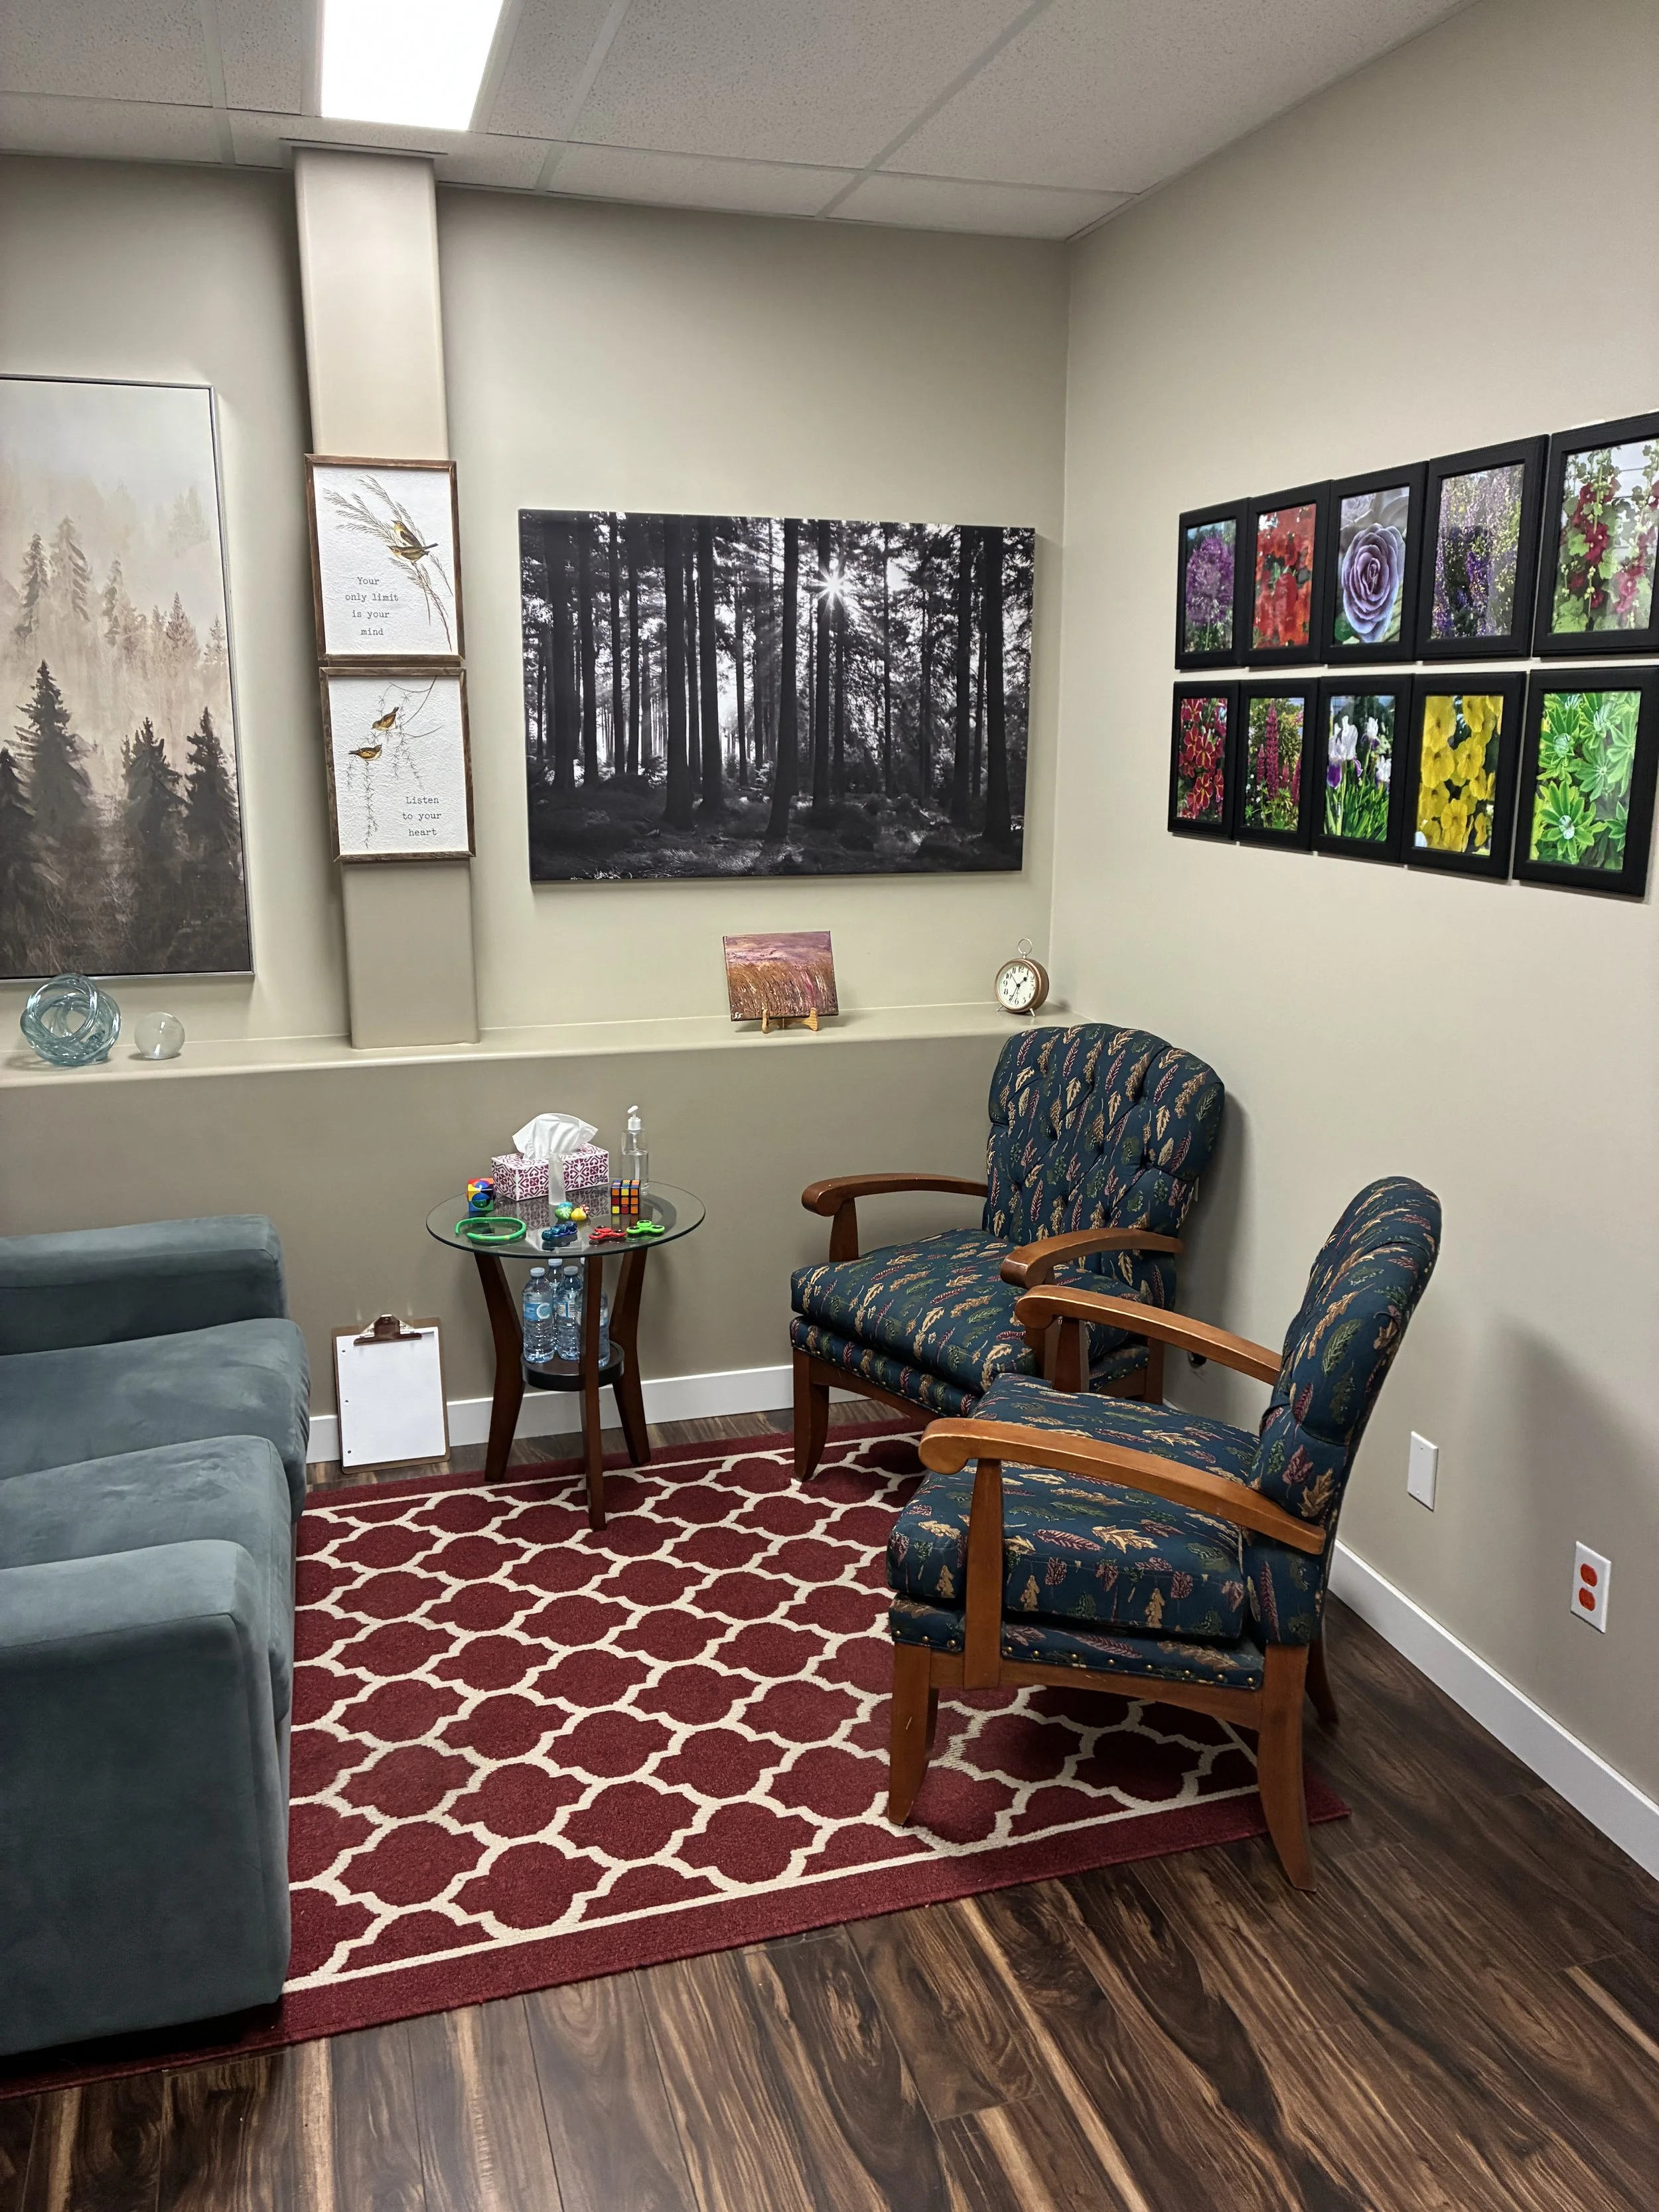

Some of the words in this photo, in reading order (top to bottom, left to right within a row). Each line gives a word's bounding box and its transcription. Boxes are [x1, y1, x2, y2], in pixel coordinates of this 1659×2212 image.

[356, 577, 380, 585] Your
[345, 593, 367, 603] only
[372, 593, 399, 601] limit
[352, 609, 362, 618] is
[405, 796, 439, 804] Listen
[401, 812, 413, 820] to
[408, 828, 437, 836] heart
